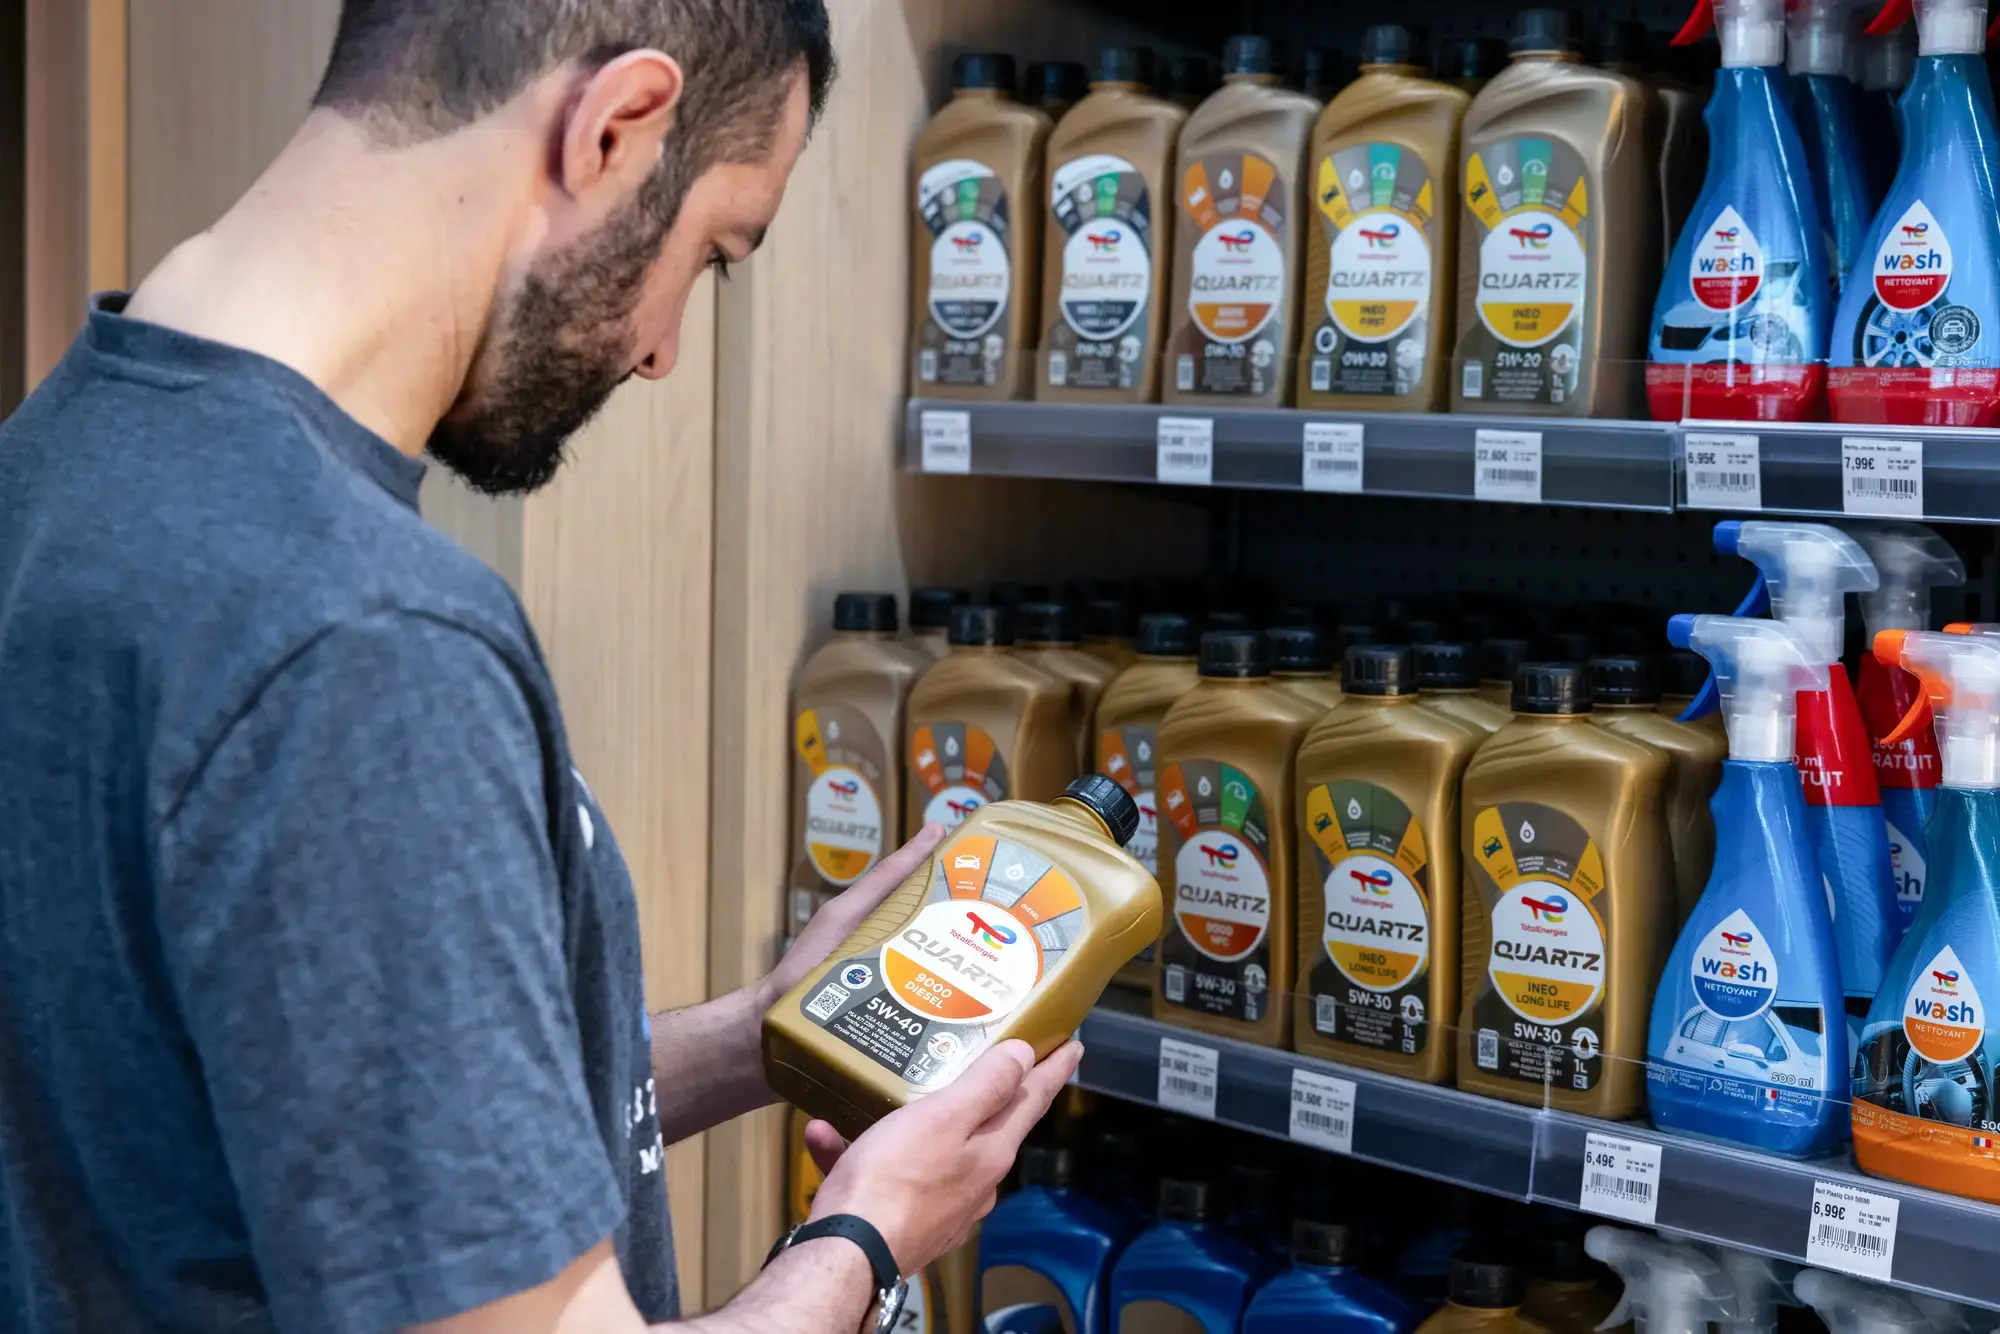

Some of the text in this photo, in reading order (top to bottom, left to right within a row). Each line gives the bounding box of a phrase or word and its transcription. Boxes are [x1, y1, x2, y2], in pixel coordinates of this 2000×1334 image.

[1699, 252, 1754, 272] wash
[1884, 249, 1942, 270] wash
[1193, 274, 1280, 292] QUARTZ
[1332, 271, 1426, 288] QUARTZ
[1482, 272, 1581, 289] QUARTZ
[1884, 277, 1934, 287] NETTOYANT
[1688, 452, 1716, 466] 6,95€
[1844, 456, 1875, 470] 7,99€
[1872, 753, 1933, 770] RATUIT
[1178, 884, 1267, 914] QUARTZ
[1021, 903, 1039, 920] DIESEL
[1327, 911, 1424, 943] QUARTZ
[1520, 923, 1568, 937] TotalEnergies
[949, 928, 999, 962] TotalEnergies
[902, 928, 1016, 999] QUARTZ
[1359, 952, 1387, 965] INEO
[1493, 940, 1600, 972] QUARTZ
[1349, 962, 1398, 980] LONG LIFE
[1702, 956, 1767, 983] wash
[915, 972, 952, 999] 9000
[1194, 975, 1236, 995] 5W-30
[1528, 982, 1558, 996] INEO
[1704, 981, 1758, 998] NETTOYANT
[904, 980, 944, 1010] DIESEL
[1348, 988, 1392, 1010] 5W-30
[1516, 994, 1571, 1011] LONG LIFE
[1717, 995, 1742, 1005] VITRES
[864, 1014, 877, 1023] ACEA
[866, 997, 923, 1036] 5W-40
[1914, 998, 1975, 1024] wash
[843, 1015, 860, 1027] Porsche
[834, 1022, 850, 1036] Chrysler
[869, 1045, 880, 1054] Fiat
[1402, 1024, 1415, 1038] 1L
[1514, 1022, 1562, 1044] 5W-30
[1915, 1023, 1966, 1039] NETTOYANT
[862, 1033, 871, 1041] aux
[870, 1039, 891, 1053] exigences
[918, 1053, 931, 1070] 1L
[1574, 1058, 1587, 1074] 1L
[1724, 1080, 1739, 1088] SANS
[1771, 1072, 1814, 1088] 500 ml
[1723, 1086, 1745, 1094] TRACES
[1730, 1091, 1754, 1101] REFLETS
[1779, 1091, 1820, 1102] FABRICATION
[1779, 1096, 1813, 1107] FRANÇAISE
[1859, 1117, 1875, 1127] NEUF
[1586, 1151, 1615, 1168] 6,49€
[1584, 1184, 1647, 1204] 3 217770 310100
[1826, 1189, 1843, 1200] Plastiq
[1813, 1201, 1846, 1220] 6,99€
[1811, 1236, 1881, 1259] 3 217770 310117
